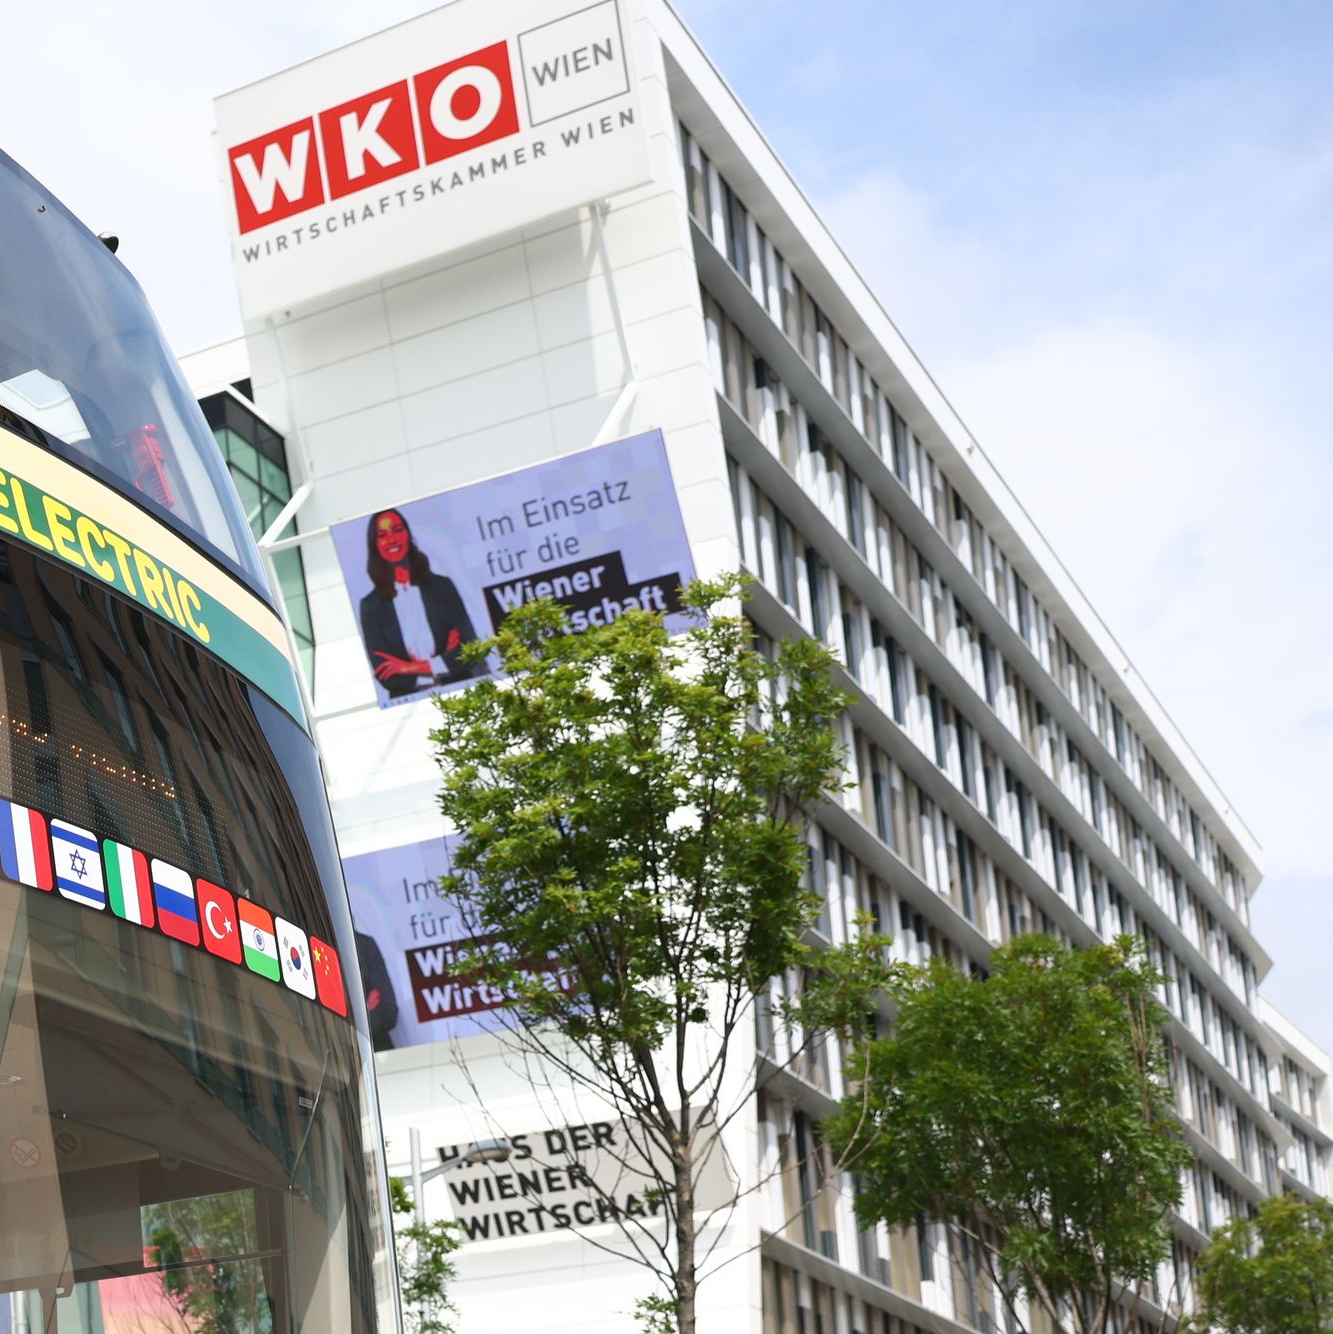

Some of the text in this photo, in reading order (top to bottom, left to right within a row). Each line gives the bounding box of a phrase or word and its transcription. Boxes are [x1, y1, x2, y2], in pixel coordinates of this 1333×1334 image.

[233, 38, 614, 216] WKO WIEN
[242, 107, 635, 263] WIRTSCHAFTSKAMMER WIEN
[476, 478, 632, 542] Im Einsatz
[485, 533, 581, 578] für die
[492, 565, 606, 613] Wiener
[410, 913, 451, 941] für
[544, 1121, 617, 1156] DER
[448, 1164, 594, 1206] WIENER
